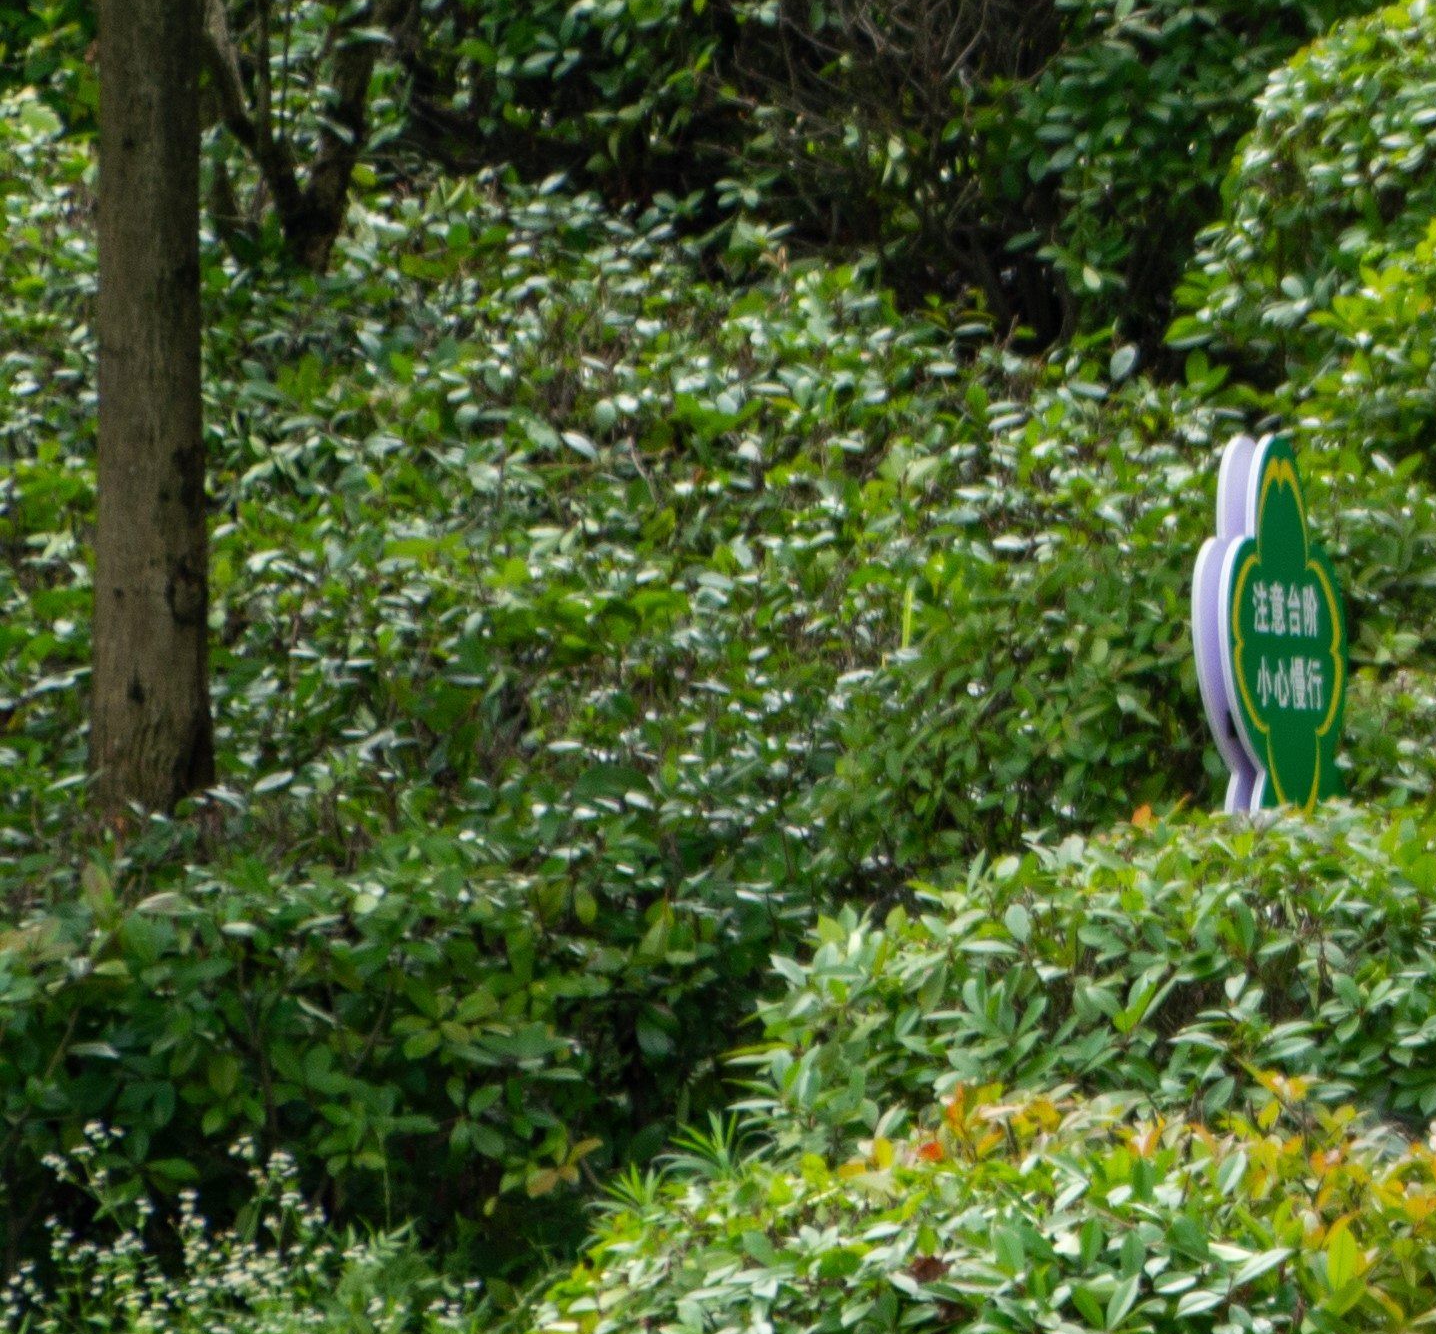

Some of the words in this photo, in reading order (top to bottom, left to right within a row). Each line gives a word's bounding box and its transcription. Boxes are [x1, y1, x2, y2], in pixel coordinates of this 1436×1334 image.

[1252, 580, 1318, 638] 注意台阶
[1256, 655, 1324, 710] 小心慢行
